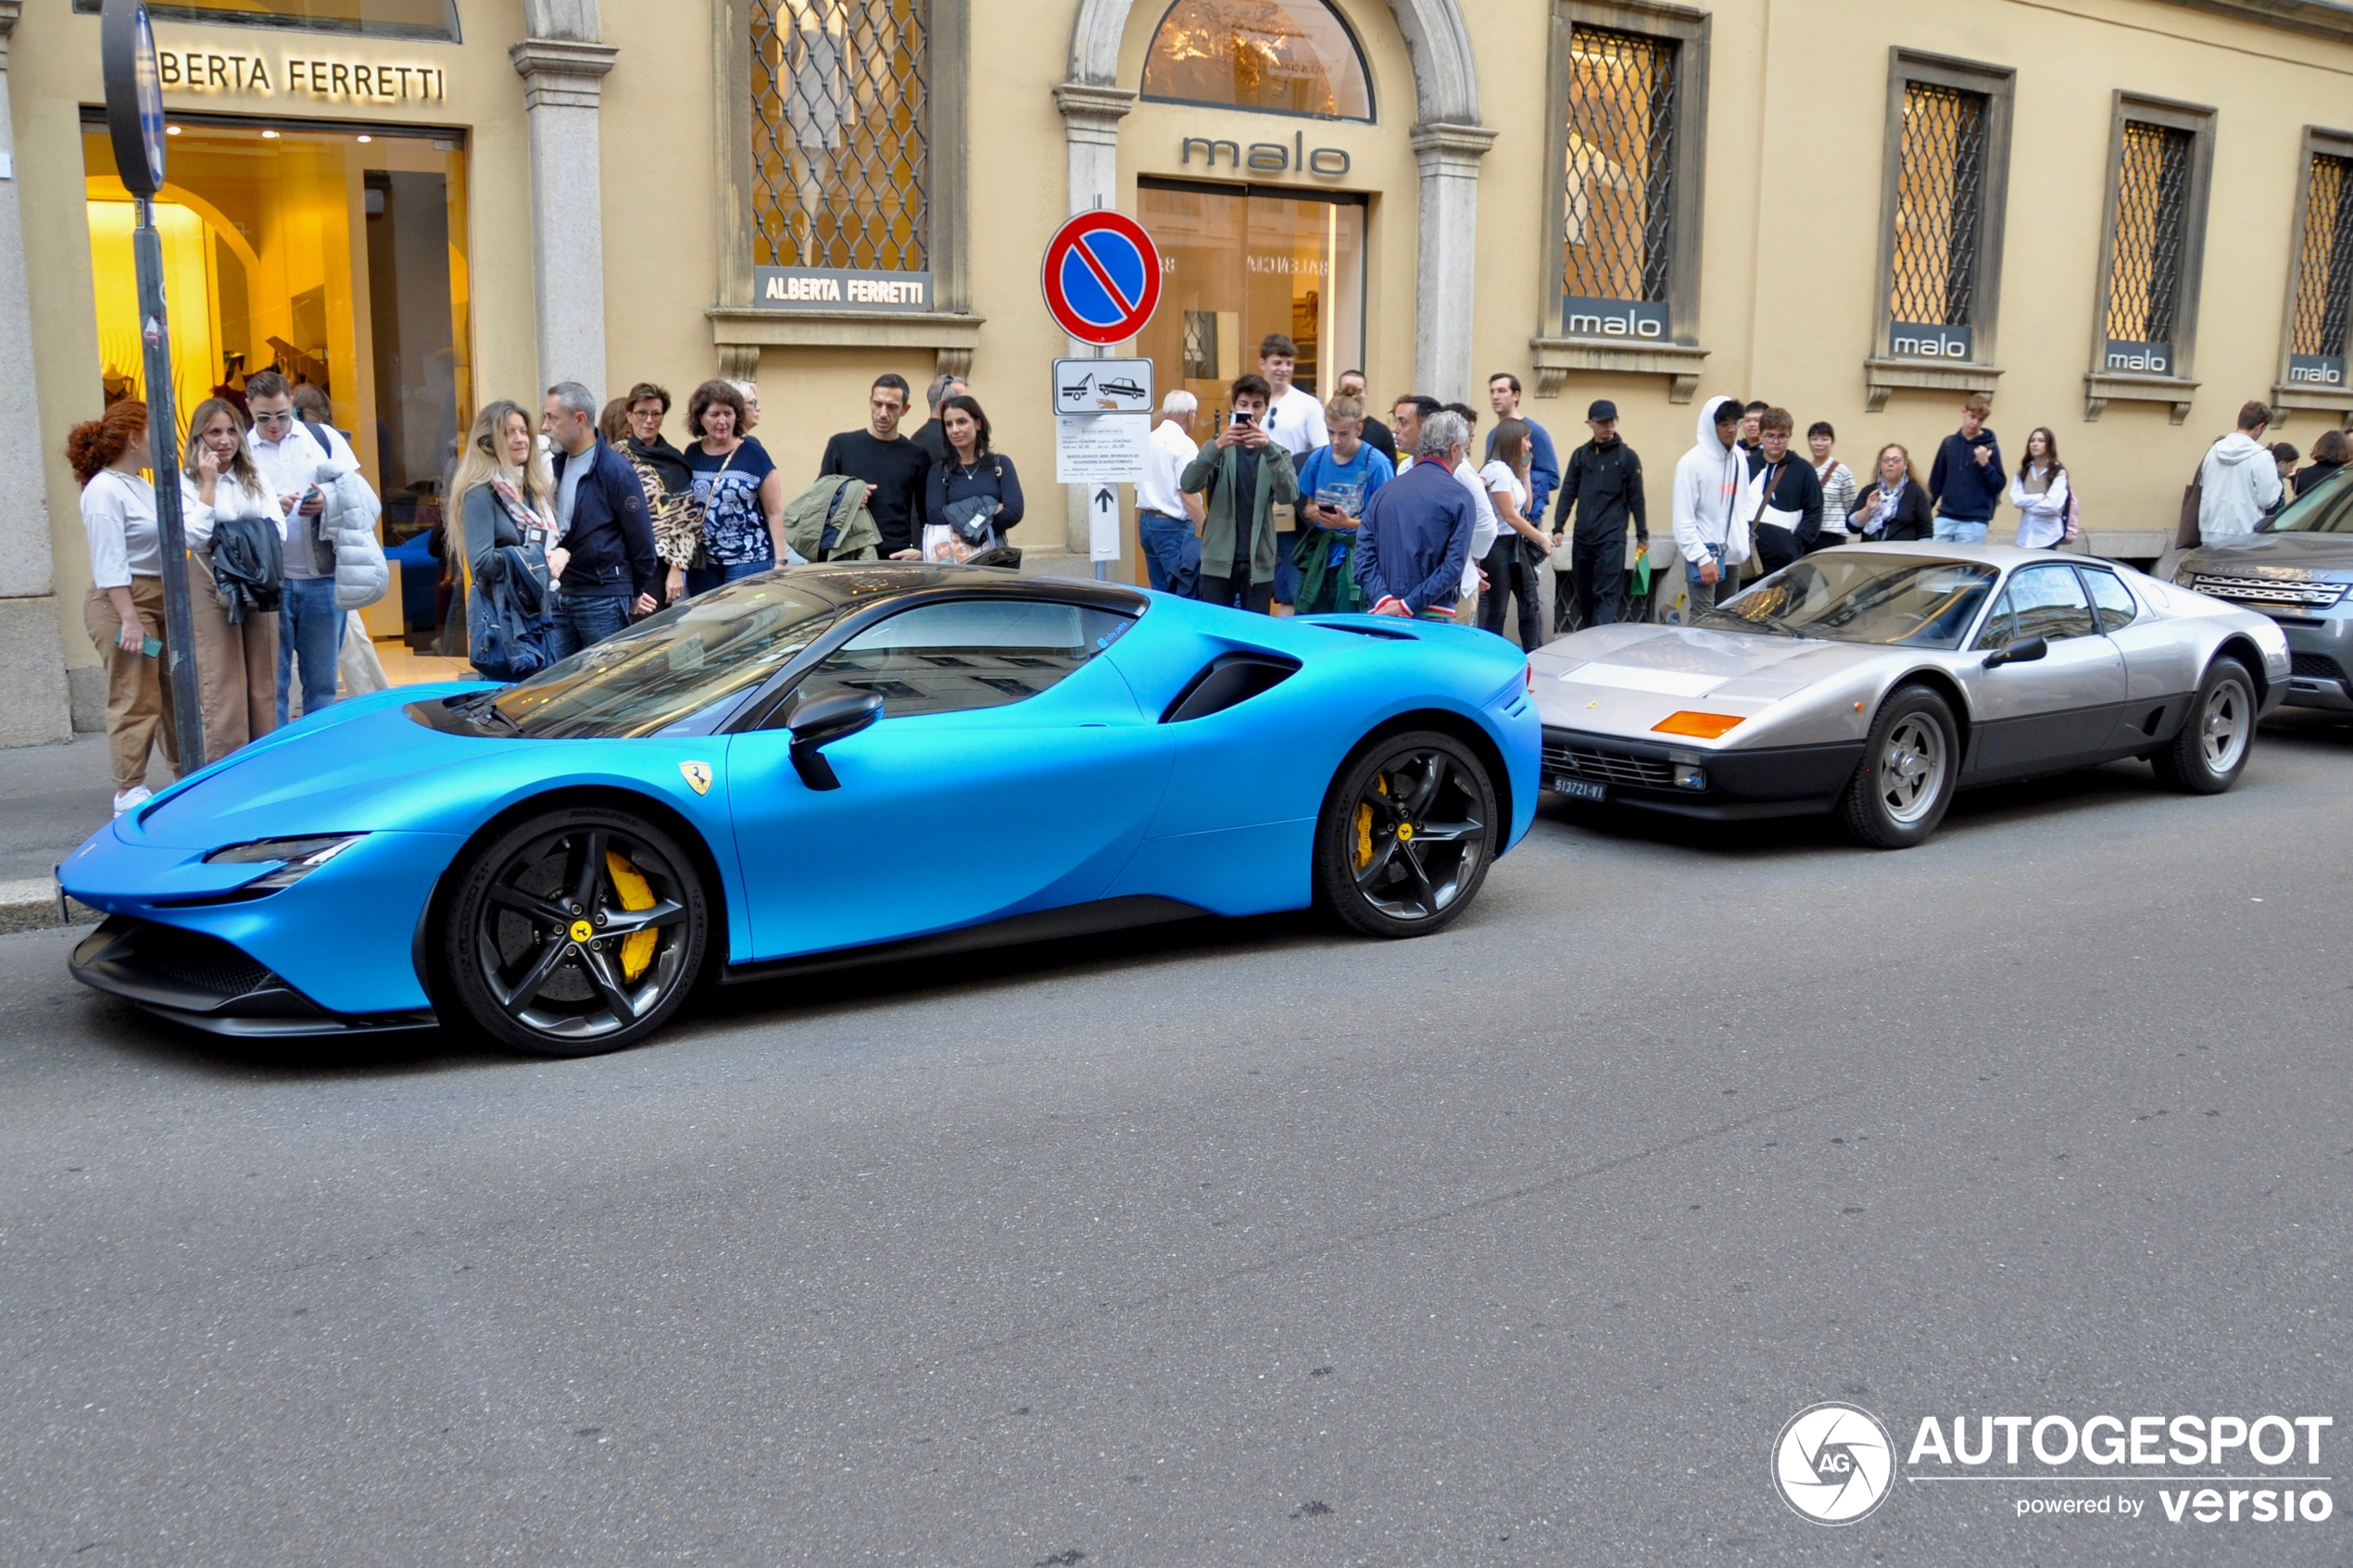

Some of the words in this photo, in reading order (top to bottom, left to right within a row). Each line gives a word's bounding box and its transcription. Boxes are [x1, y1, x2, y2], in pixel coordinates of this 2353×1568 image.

[160, 52, 270, 89] BERTA
[289, 60, 443, 99] FERRETTI
[1183, 131, 1351, 175] malo
[765, 277, 841, 301] ALBERTA
[847, 280, 924, 304] FERRETTI
[1569, 308, 1661, 337] malo
[1894, 332, 1966, 358] malo
[2107, 349, 2166, 371] malo
[2290, 362, 2340, 383] malo
